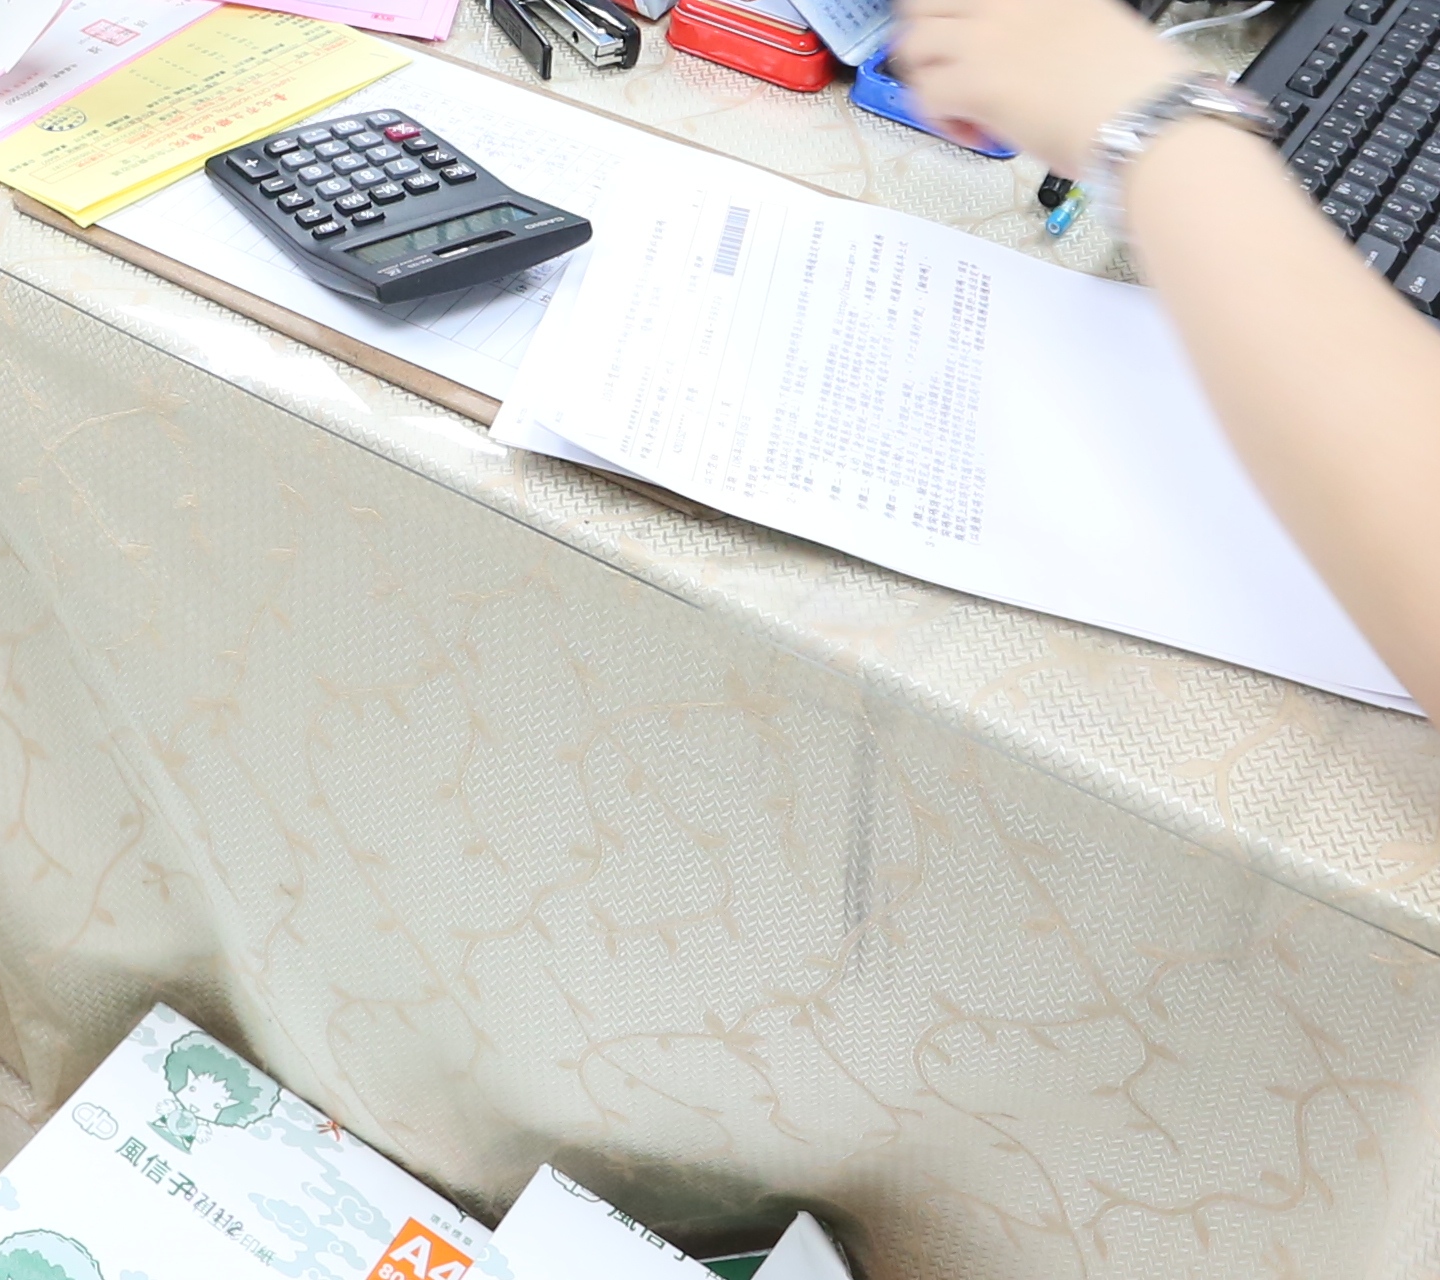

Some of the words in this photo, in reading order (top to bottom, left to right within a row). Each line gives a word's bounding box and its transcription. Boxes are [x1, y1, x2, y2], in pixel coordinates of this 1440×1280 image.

[165, 90, 290, 151] 臺北市立聯合醫院
[523, 214, 566, 231] CASIO
[114, 1135, 196, 1197] 風信子
[388, 1233, 469, 1280] A4
